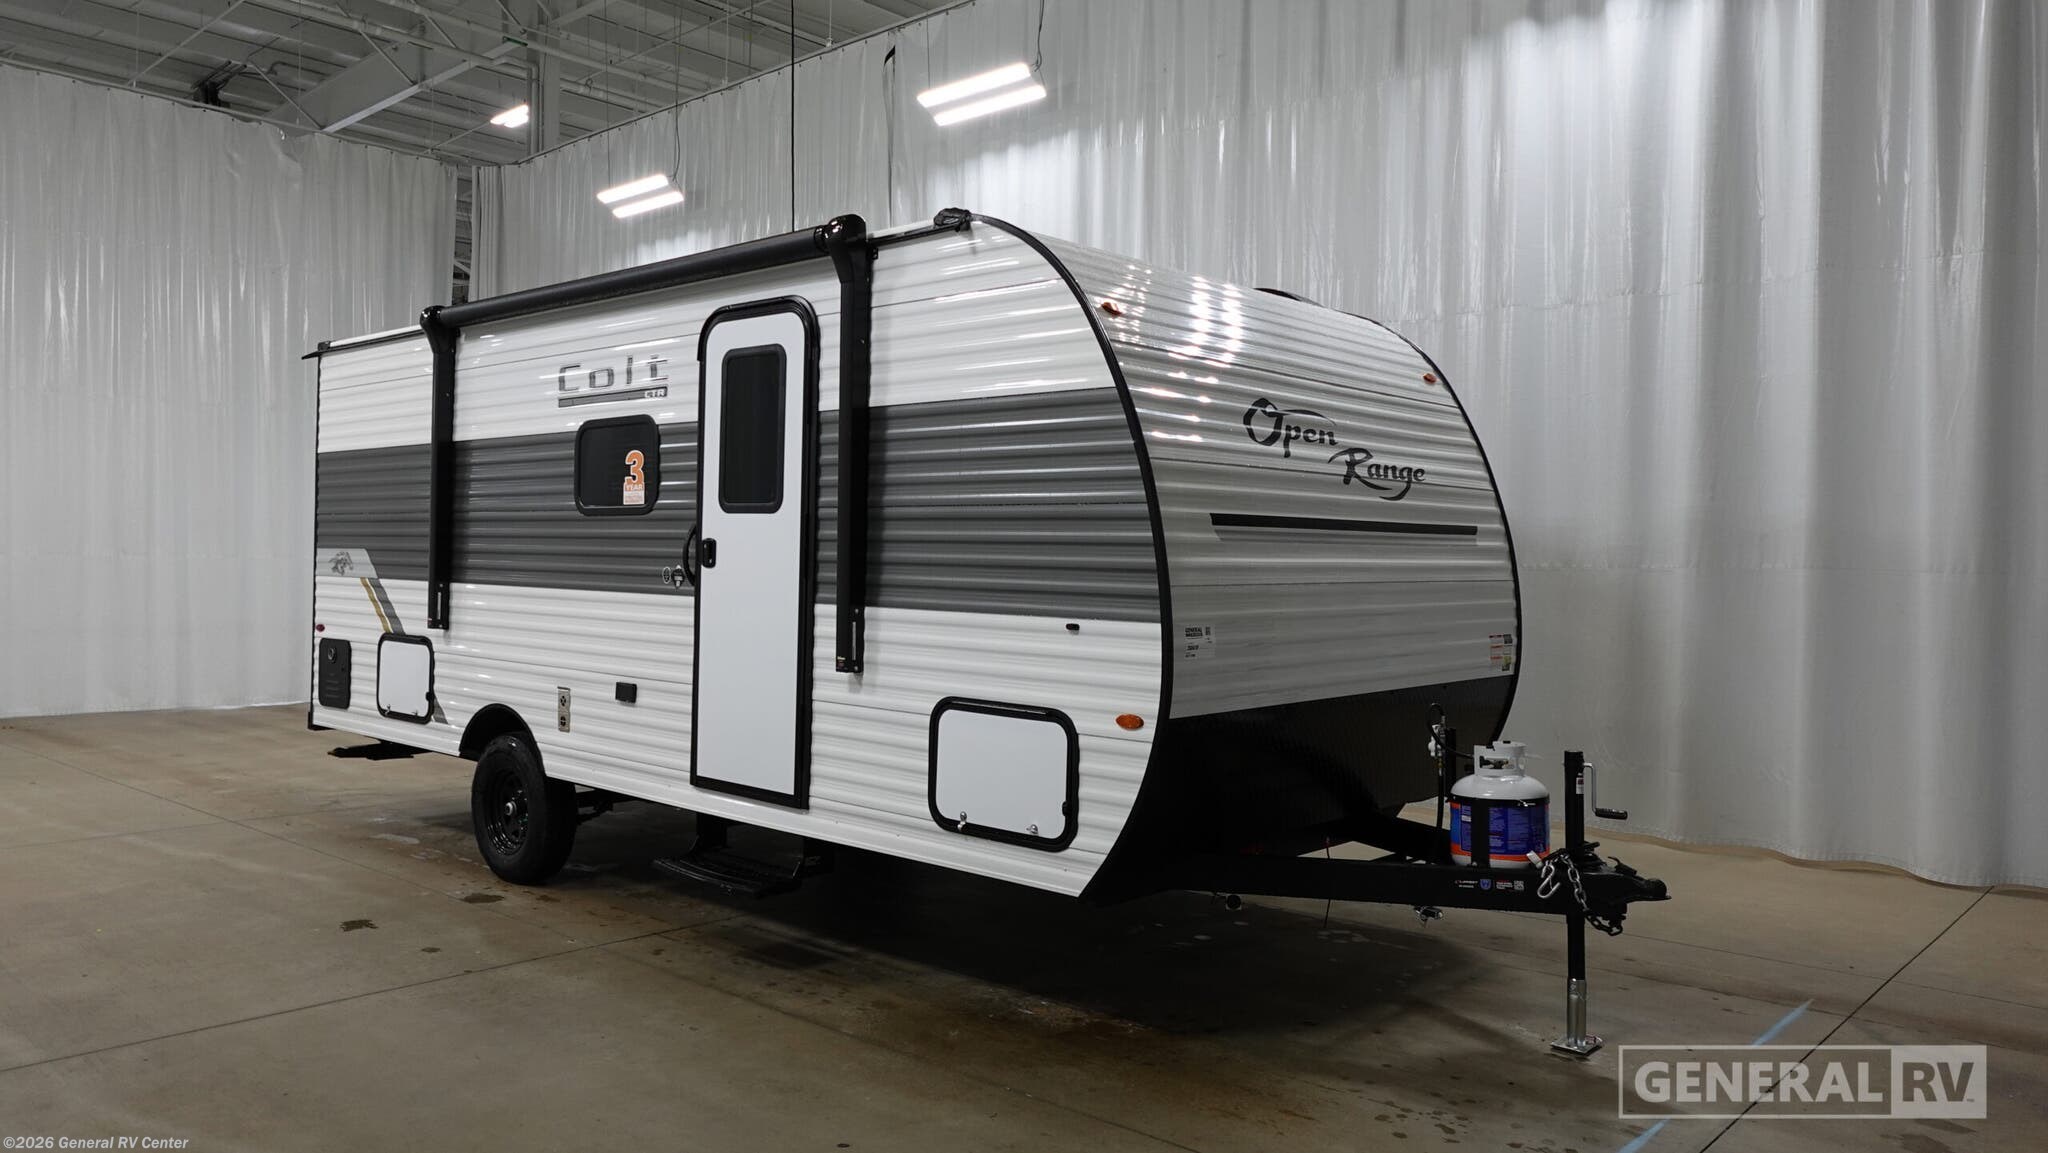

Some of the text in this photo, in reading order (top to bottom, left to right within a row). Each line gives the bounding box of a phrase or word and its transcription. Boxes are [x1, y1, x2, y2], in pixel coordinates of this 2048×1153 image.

[558, 355, 668, 391] Colt
[1243, 398, 1338, 458] Open
[625, 450, 644, 484] 3
[1328, 448, 1426, 500] Range
